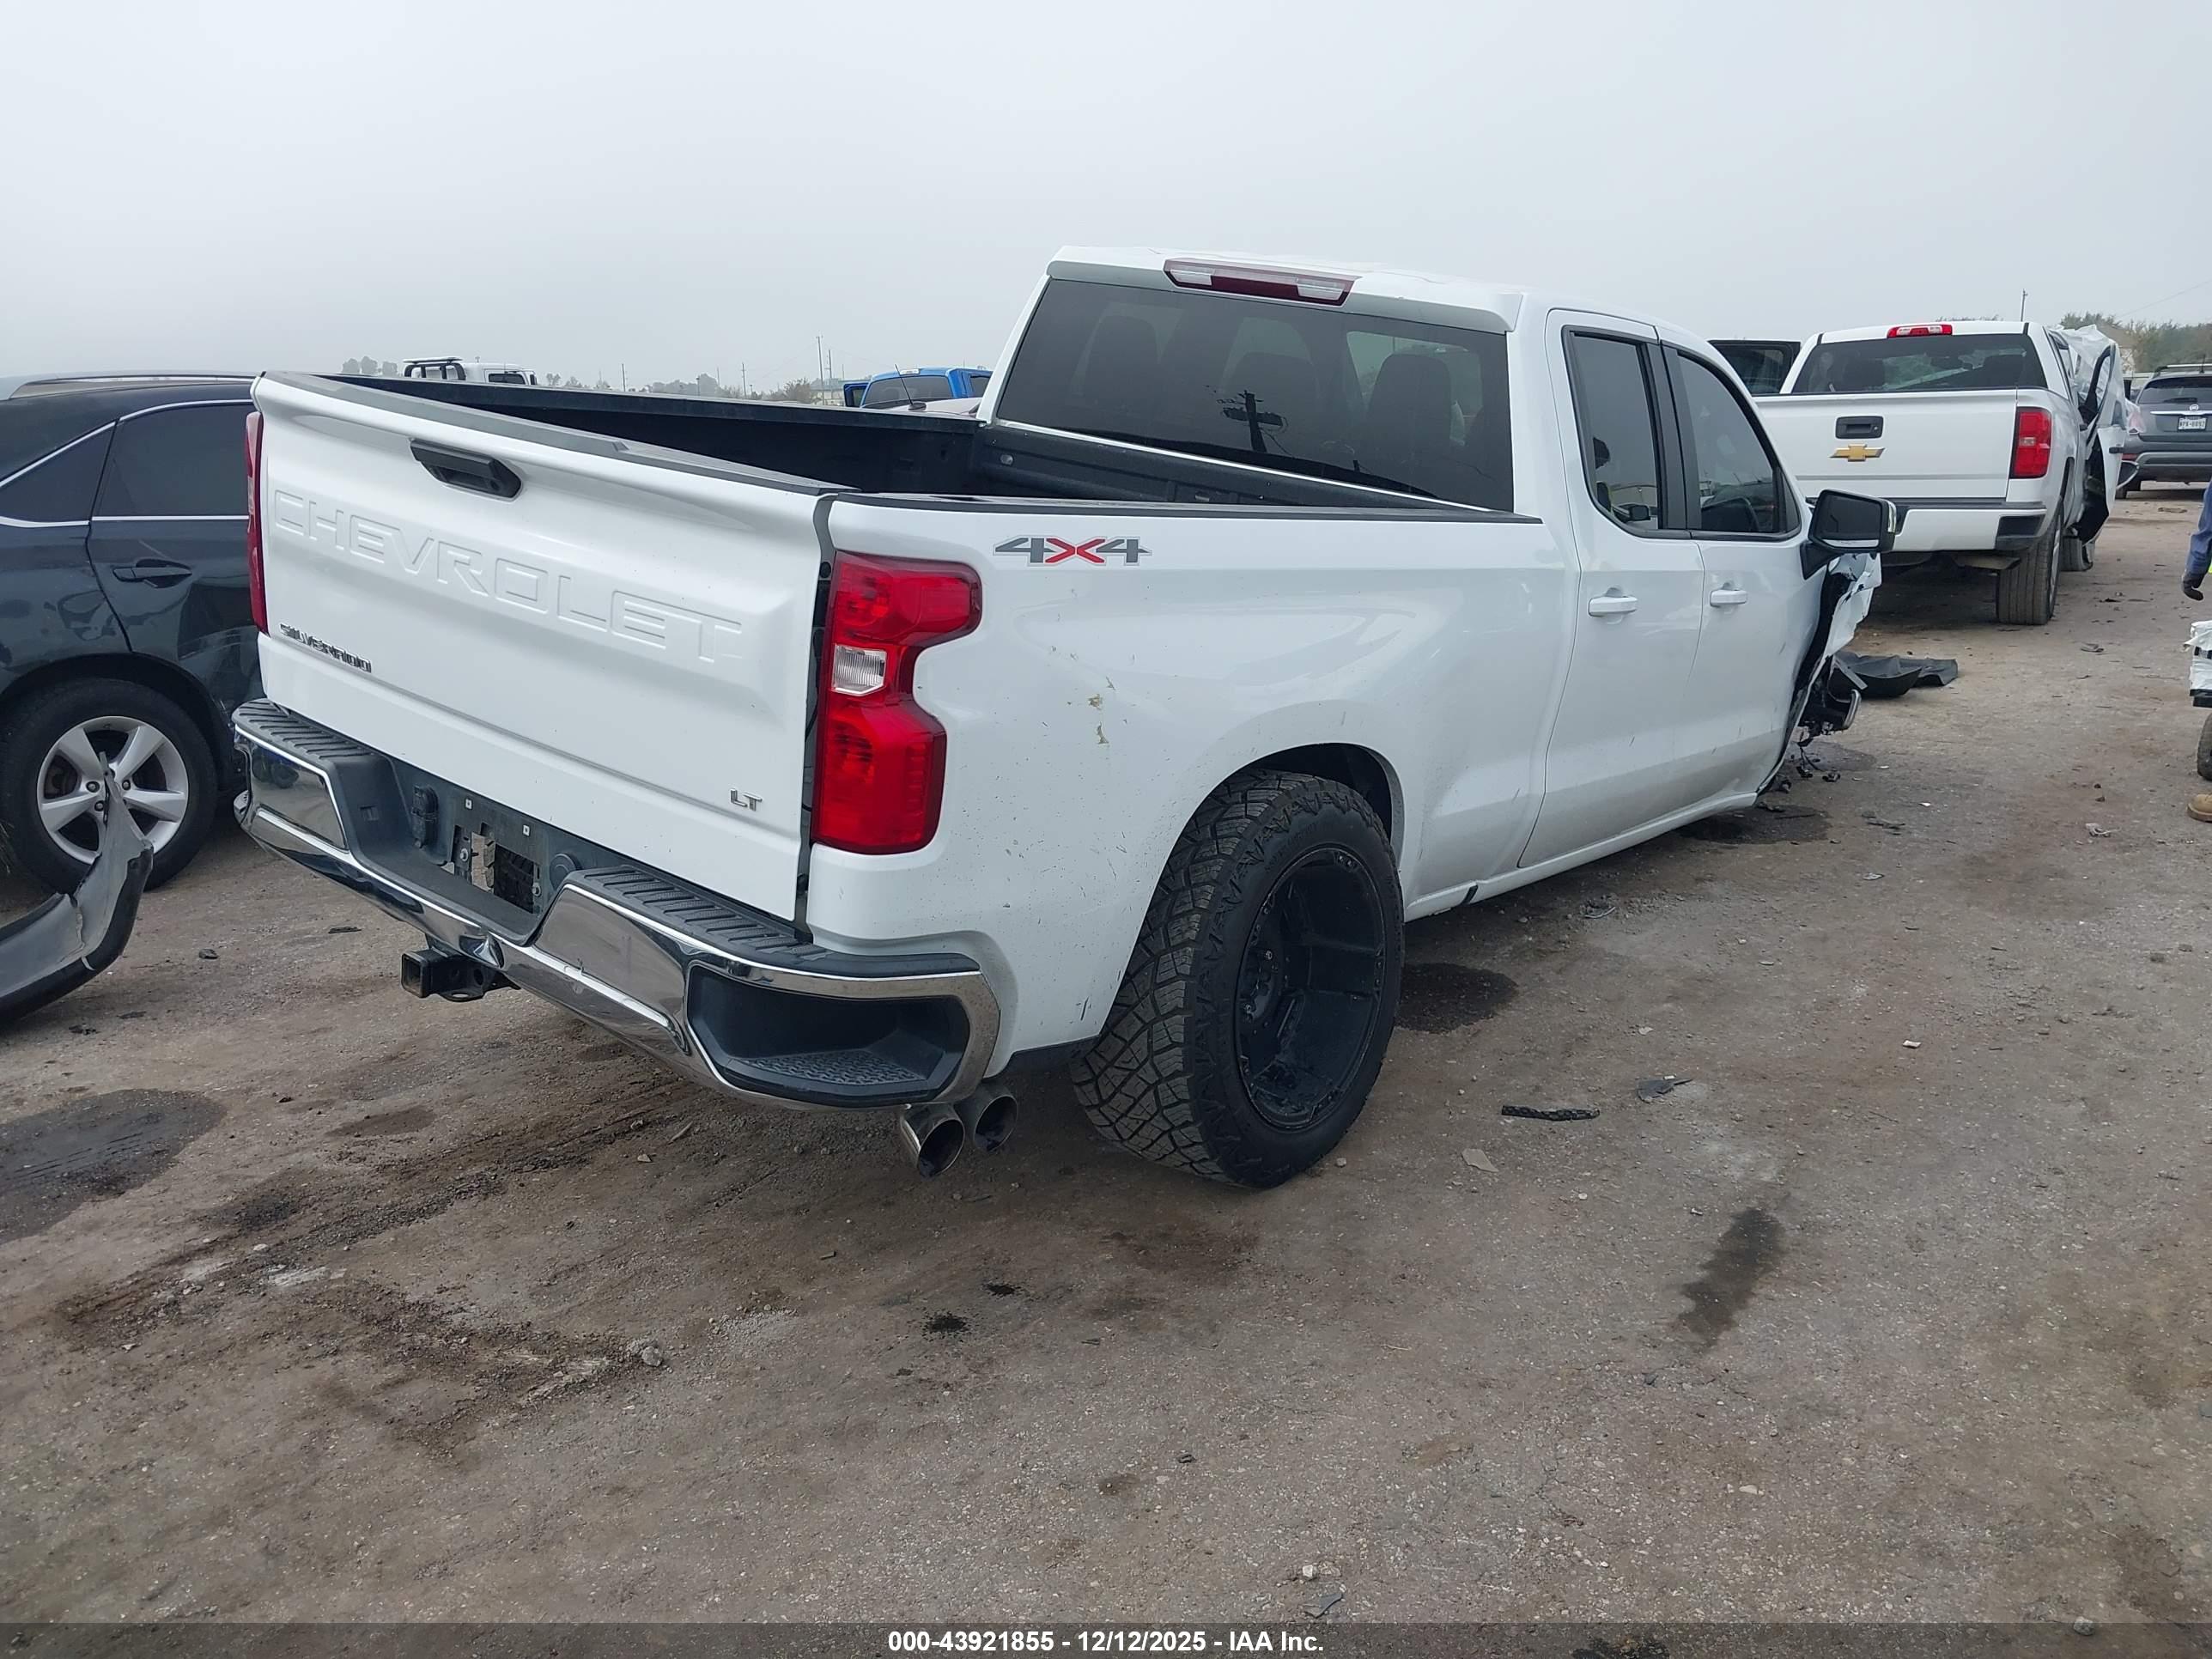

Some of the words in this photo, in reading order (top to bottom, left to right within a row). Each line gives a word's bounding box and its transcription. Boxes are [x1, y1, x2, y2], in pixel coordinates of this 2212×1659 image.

[994, 536, 1151, 565] 4X4
[274, 489, 743, 663] CHEVROLET
[279, 623, 372, 673] SILVERADO
[730, 788, 763, 811] LT
